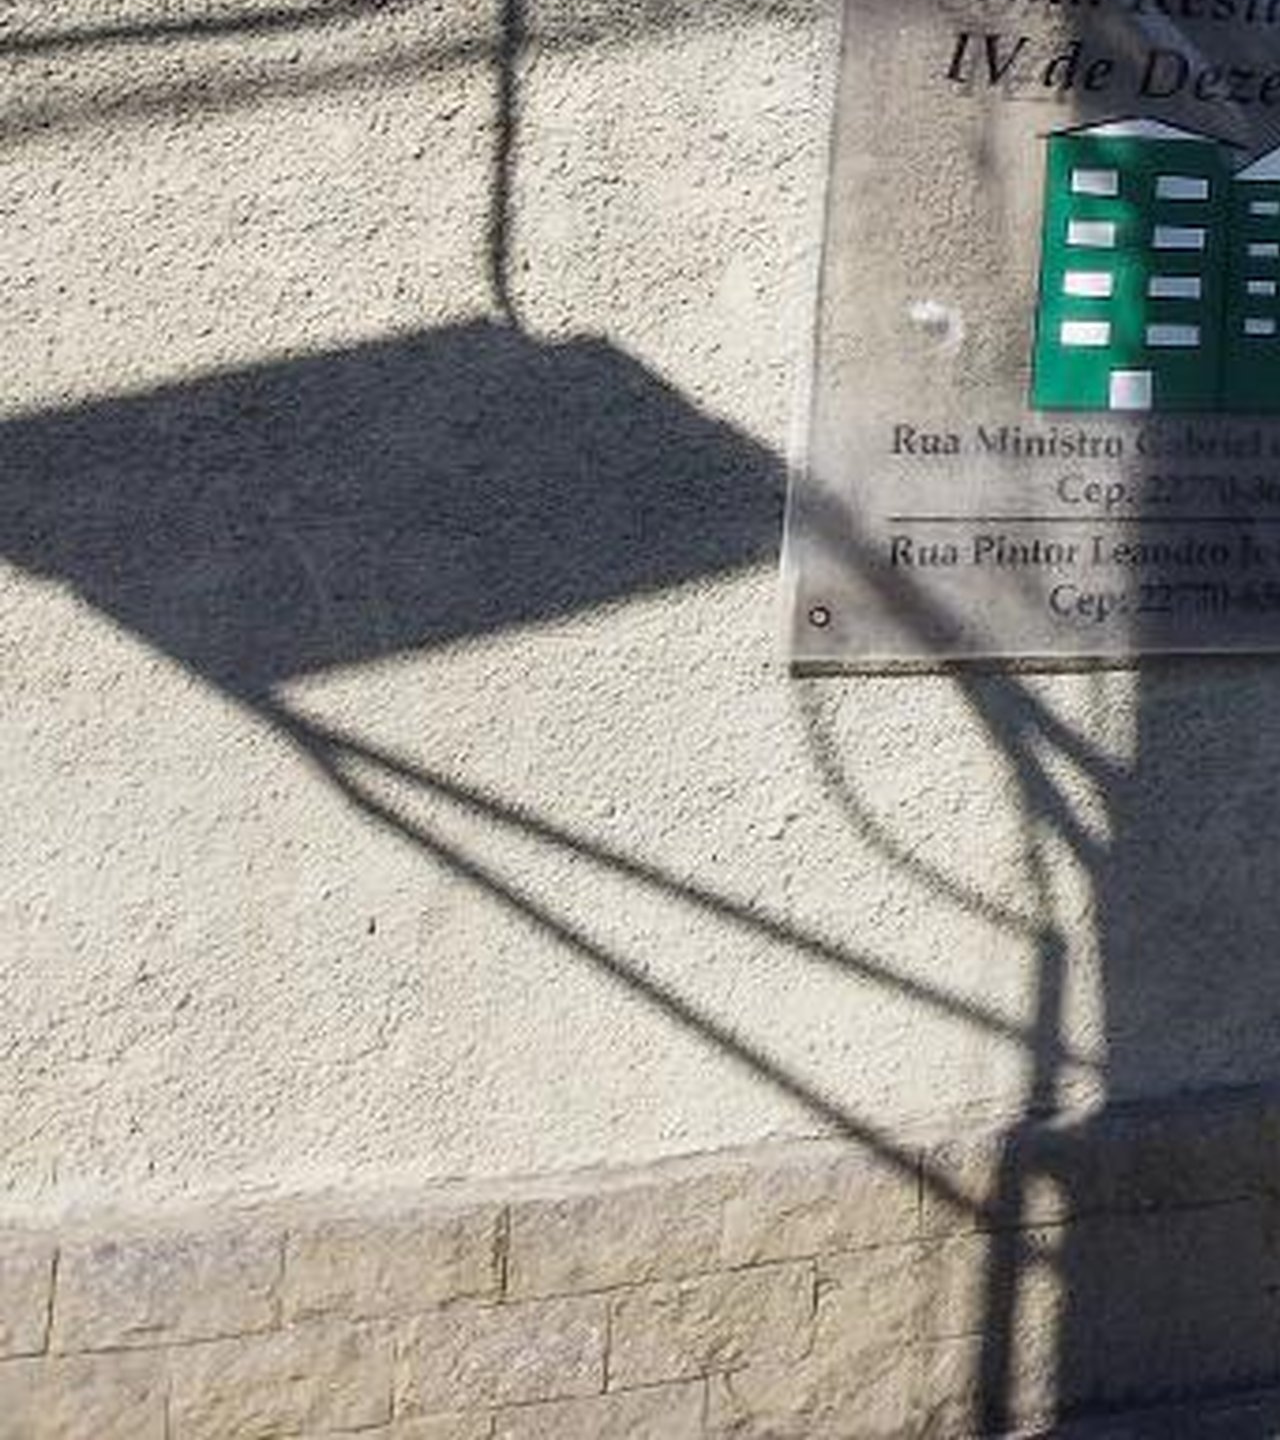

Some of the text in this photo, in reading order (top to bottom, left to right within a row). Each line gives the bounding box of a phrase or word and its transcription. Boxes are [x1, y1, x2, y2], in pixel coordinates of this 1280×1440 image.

[944, 30, 1030, 88] IV
[1044, 38, 1116, 94] de
[892, 423, 961, 456] Rua
[975, 425, 1123, 459] Ministro
[889, 534, 959, 567] Rua
[973, 535, 1078, 566] Pintor
[1091, 536, 1230, 566] Leandro
